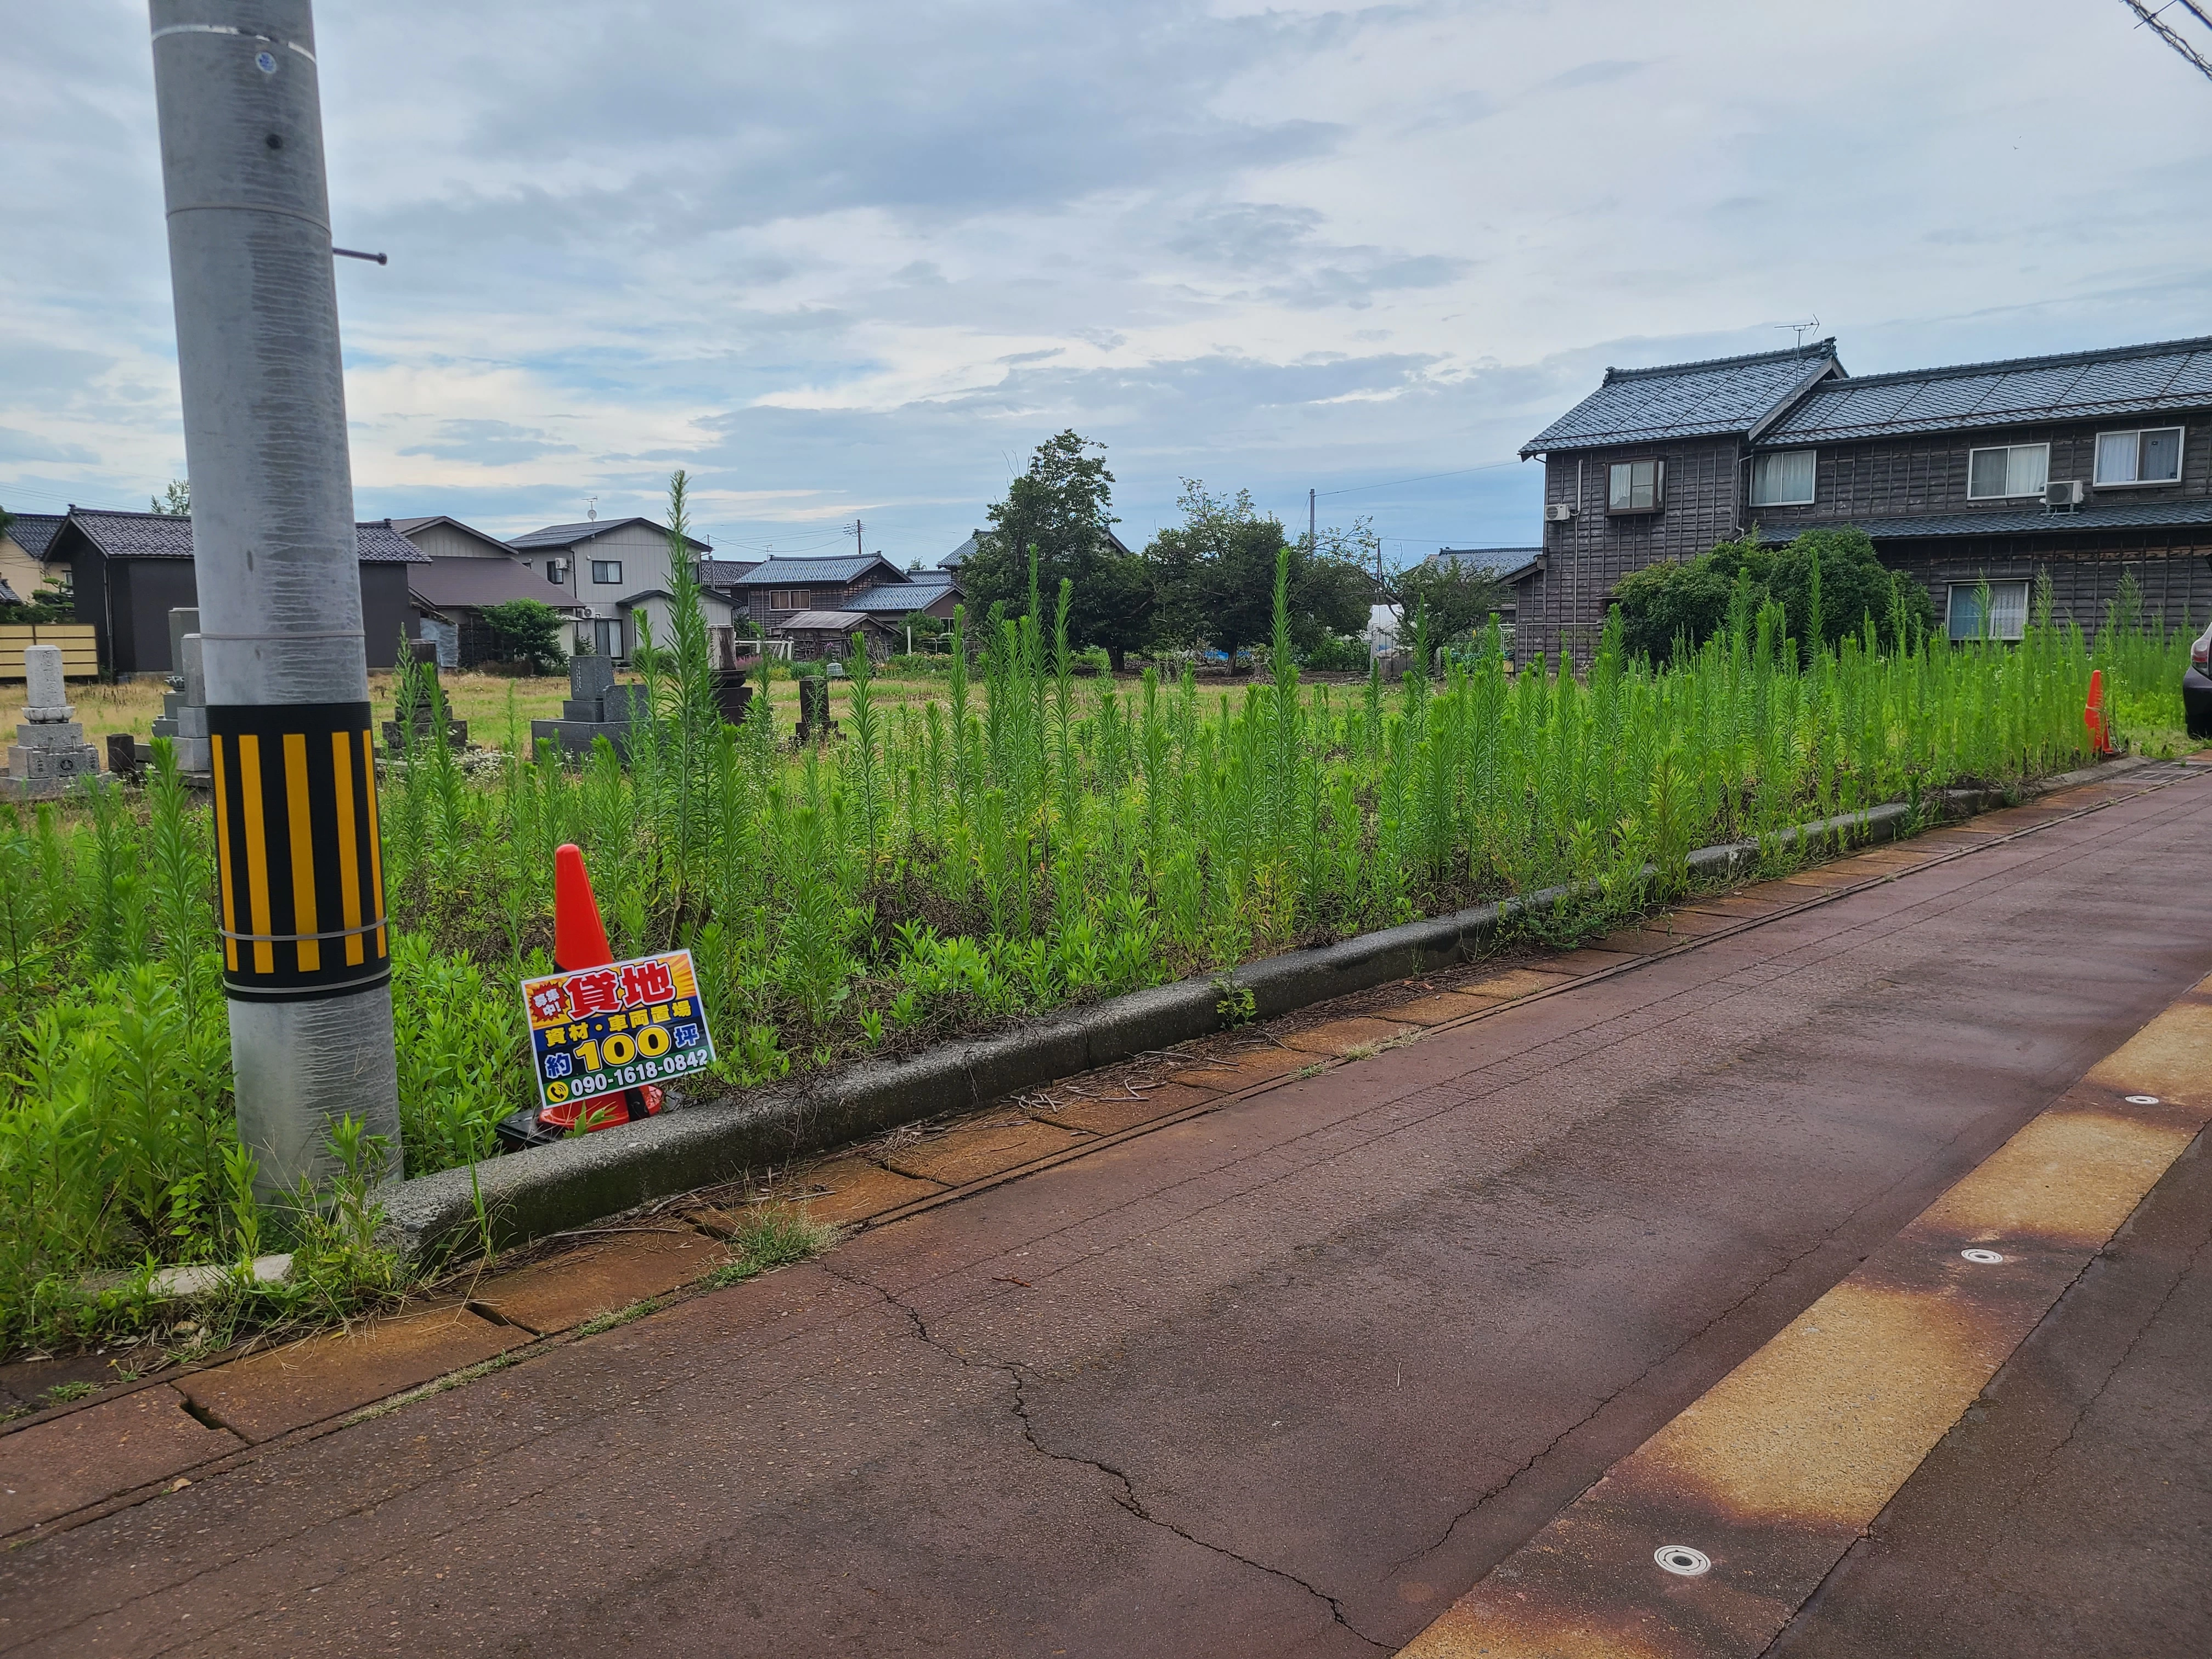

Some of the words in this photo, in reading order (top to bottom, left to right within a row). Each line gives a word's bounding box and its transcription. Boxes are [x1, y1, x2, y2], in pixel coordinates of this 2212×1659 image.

[563, 961, 675, 1020] 貸地
[545, 1000, 691, 1047] 資材・車両置場
[571, 1049, 708, 1096] 090-1618-0842
